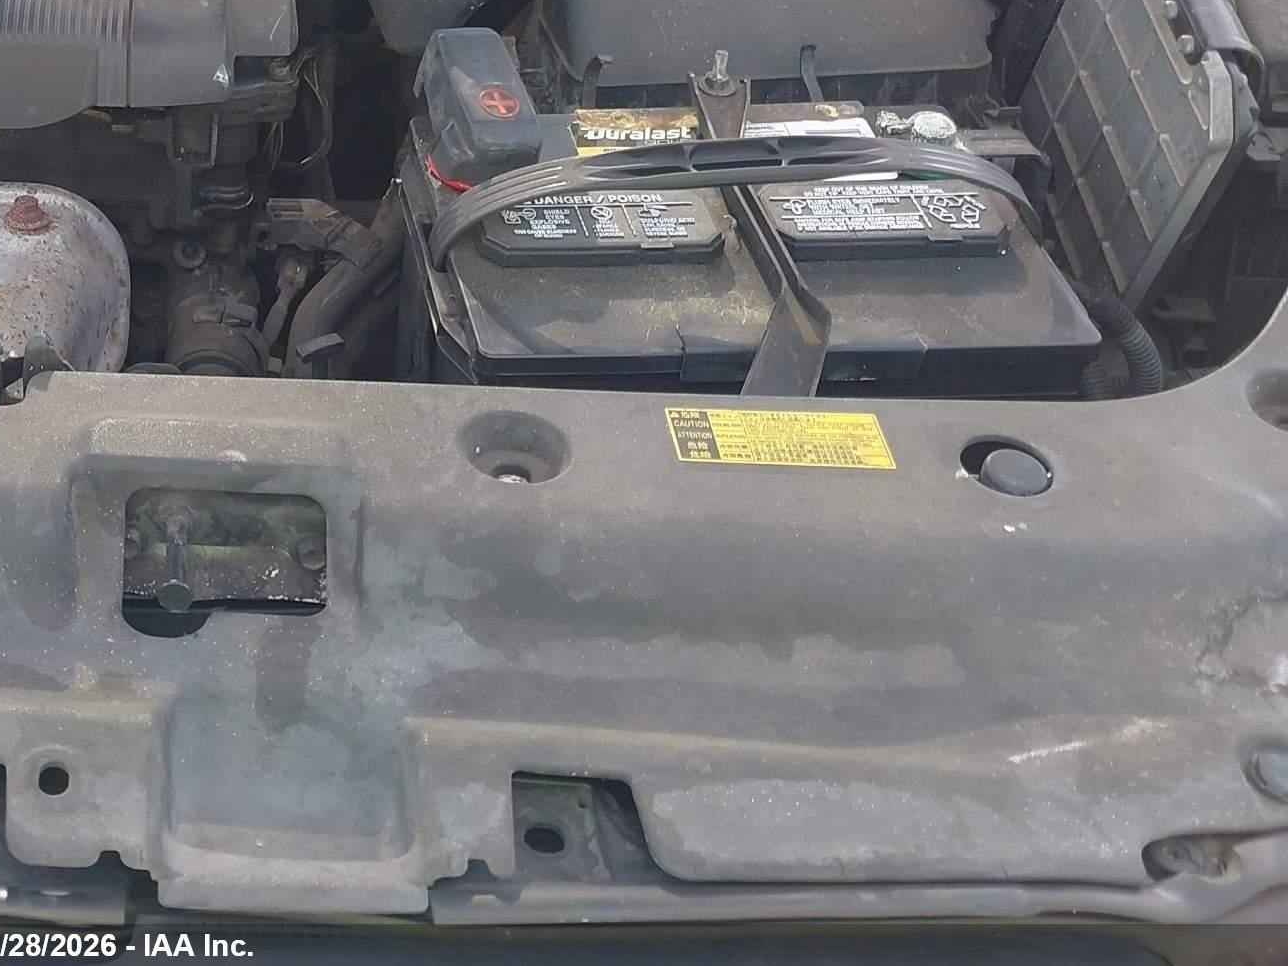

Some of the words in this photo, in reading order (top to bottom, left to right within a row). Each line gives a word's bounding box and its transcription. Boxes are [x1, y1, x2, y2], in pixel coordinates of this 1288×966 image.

[580, 126, 692, 140] Duralast
[534, 195, 594, 205] DANGER
[608, 193, 663, 203] POISON
[674, 420, 710, 428] CAUTION
[677, 431, 713, 440] ATTENTION
